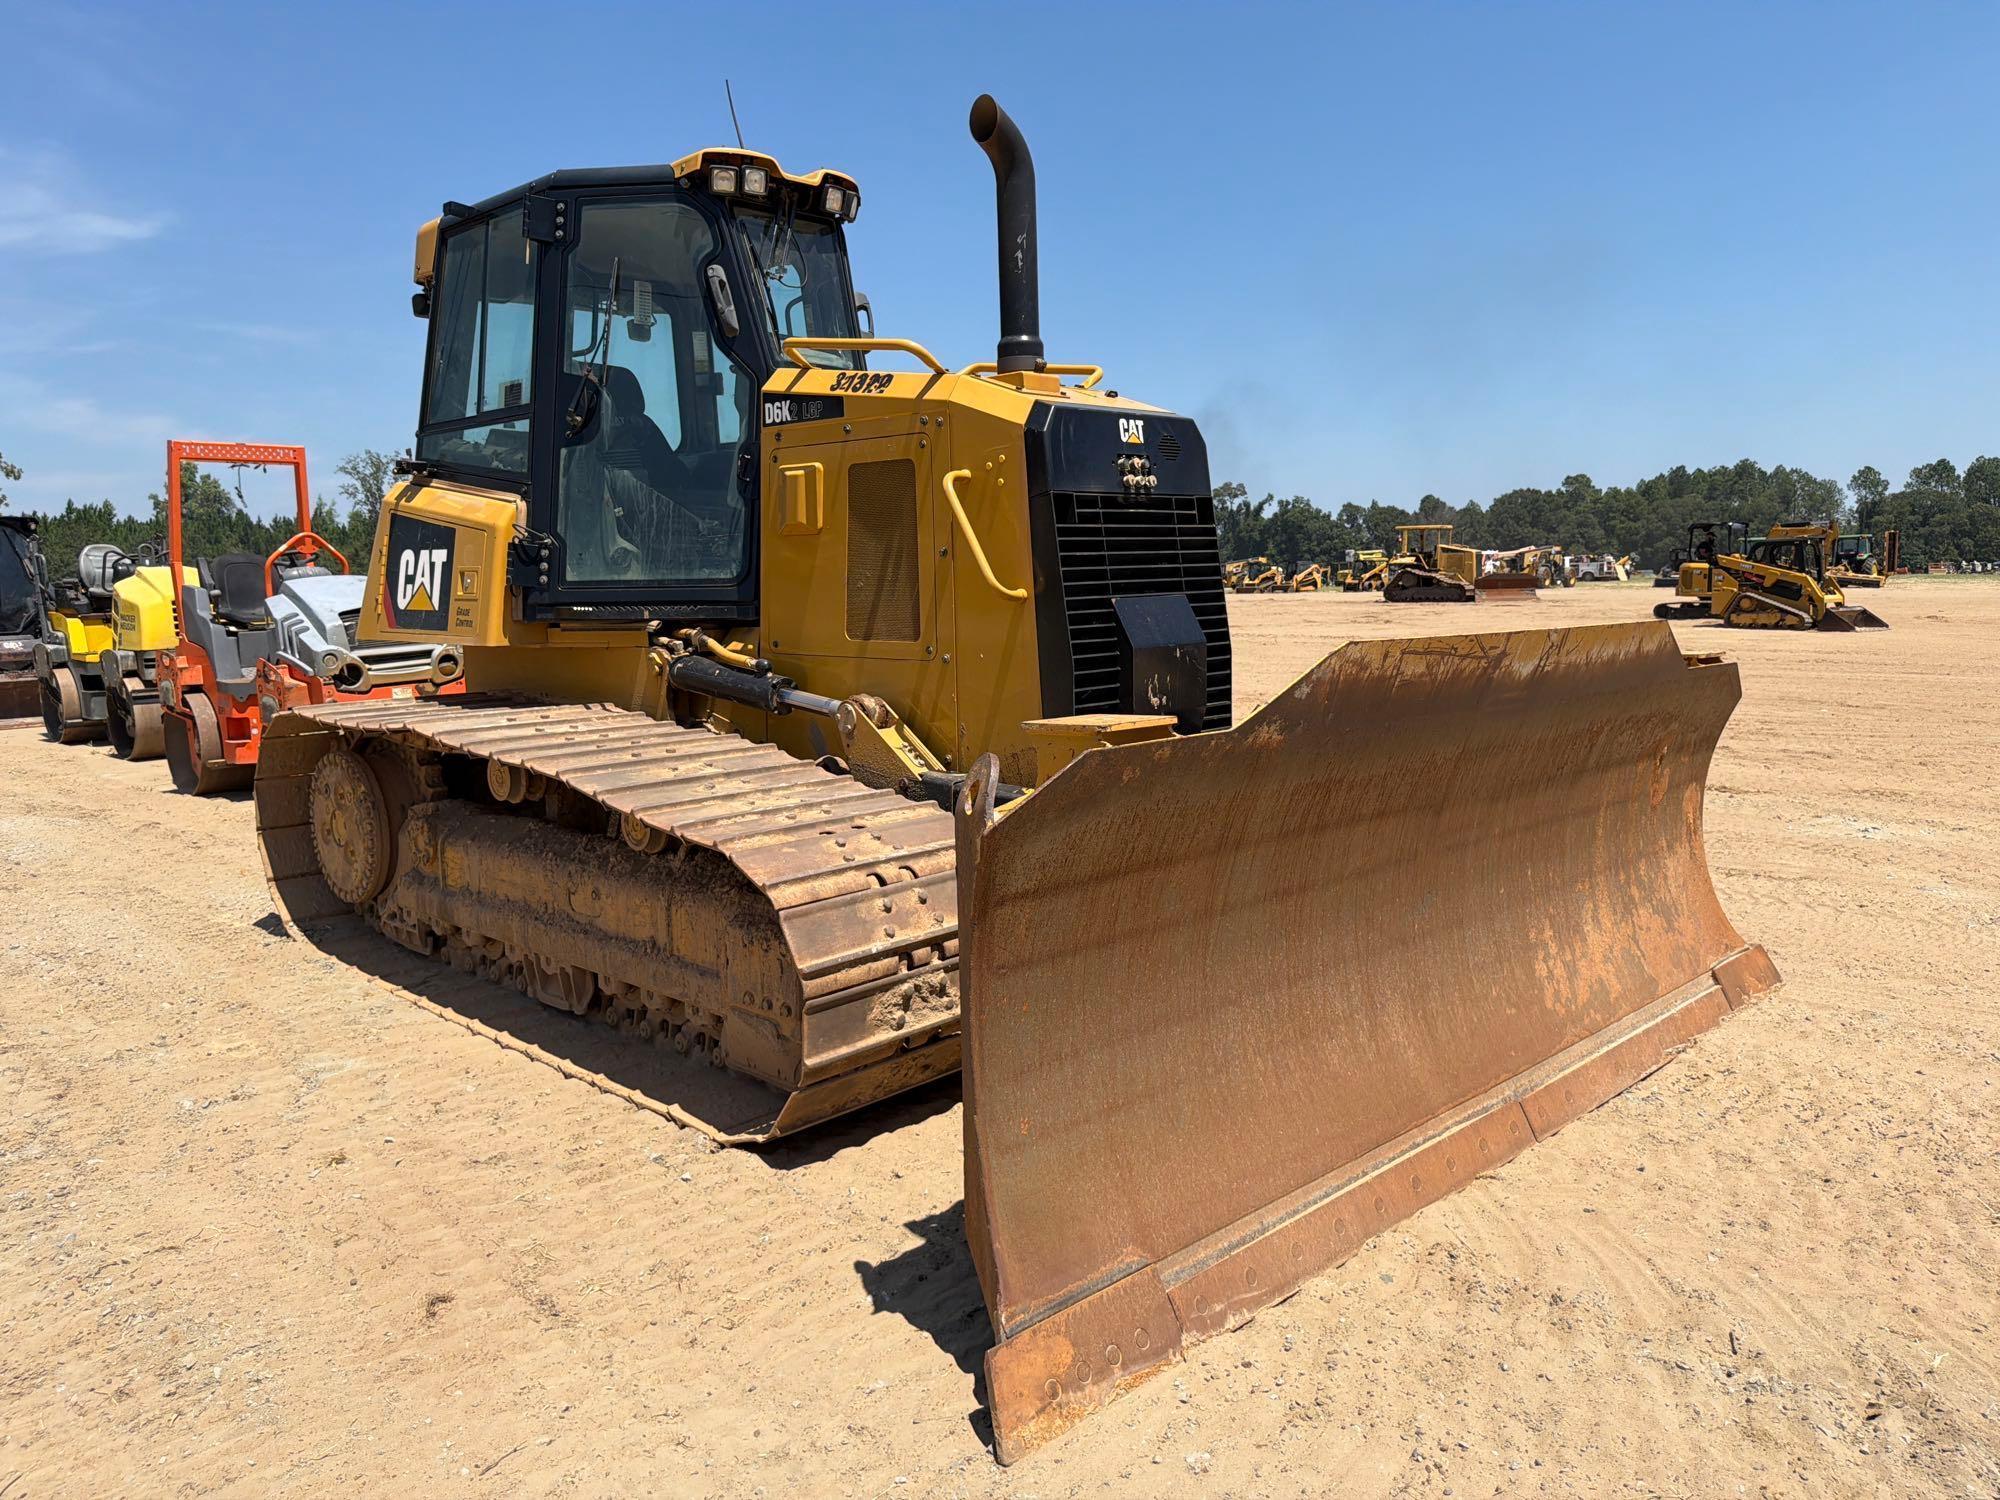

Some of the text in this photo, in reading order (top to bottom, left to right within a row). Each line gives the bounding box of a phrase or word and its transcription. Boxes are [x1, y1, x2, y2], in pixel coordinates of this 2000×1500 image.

[764, 399, 823, 424] D6K2 LGP
[1119, 418, 1144, 444] CAT
[397, 549, 448, 611] CAT
